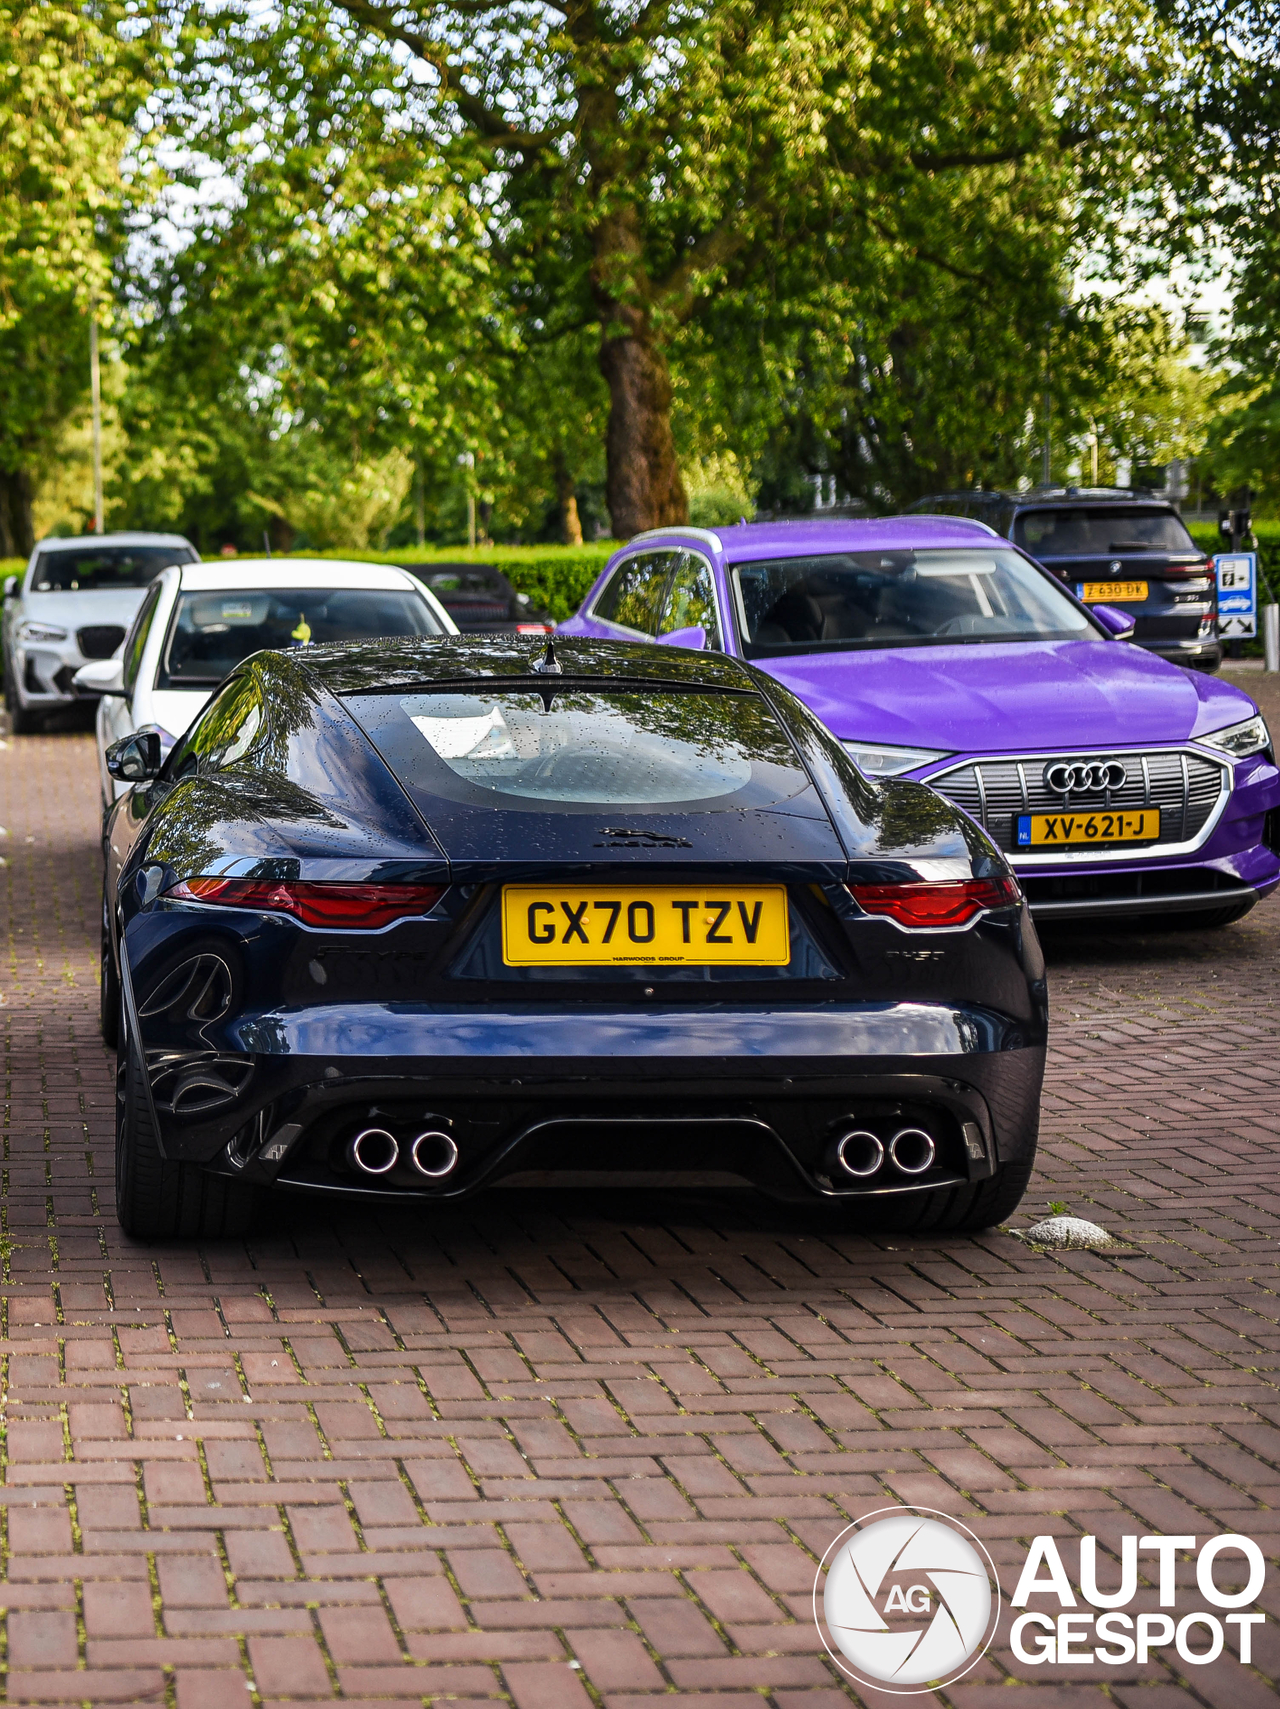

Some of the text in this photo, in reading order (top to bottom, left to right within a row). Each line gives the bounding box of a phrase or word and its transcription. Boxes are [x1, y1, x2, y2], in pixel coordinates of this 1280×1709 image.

[1044, 813, 1144, 840] XV-621-J
[527, 901, 764, 945] GX70 TZV
